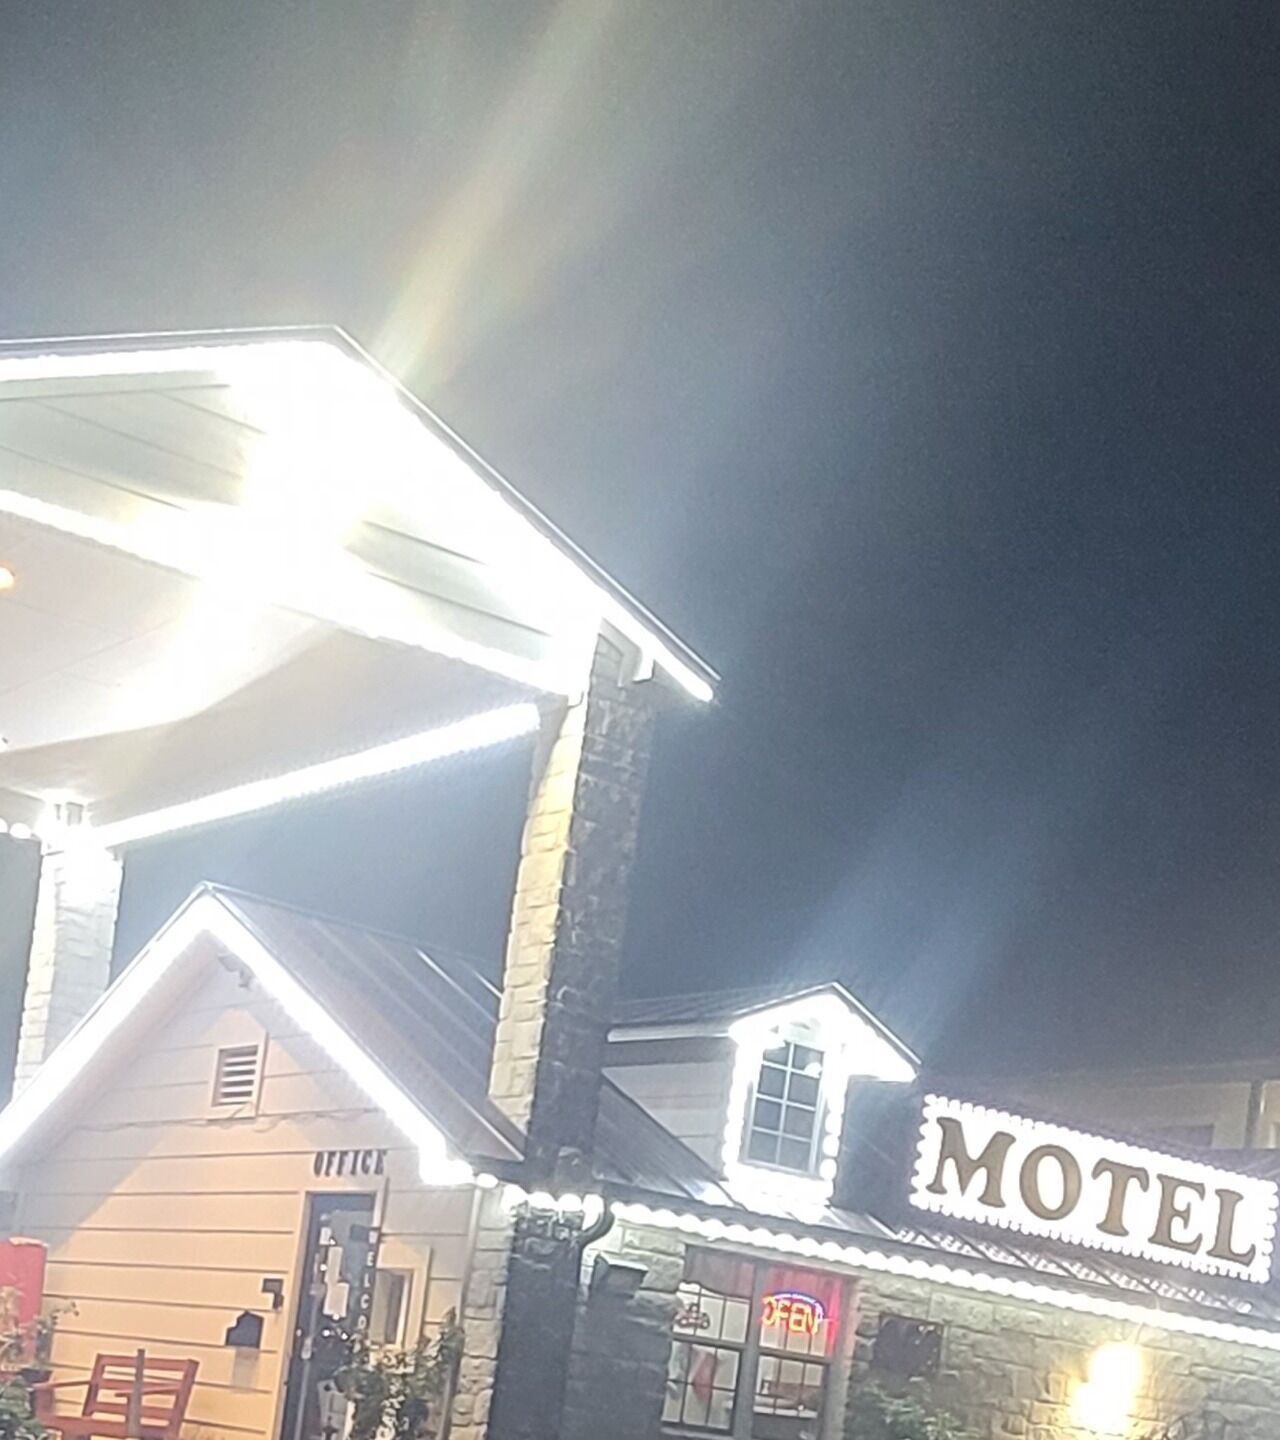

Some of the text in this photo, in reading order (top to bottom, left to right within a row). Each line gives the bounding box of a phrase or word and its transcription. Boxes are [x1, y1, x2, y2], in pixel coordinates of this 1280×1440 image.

[314, 1149, 388, 1177] OFFICE
[926, 1117, 1256, 1266] MOTEL
[762, 1296, 821, 1335] OPEN
